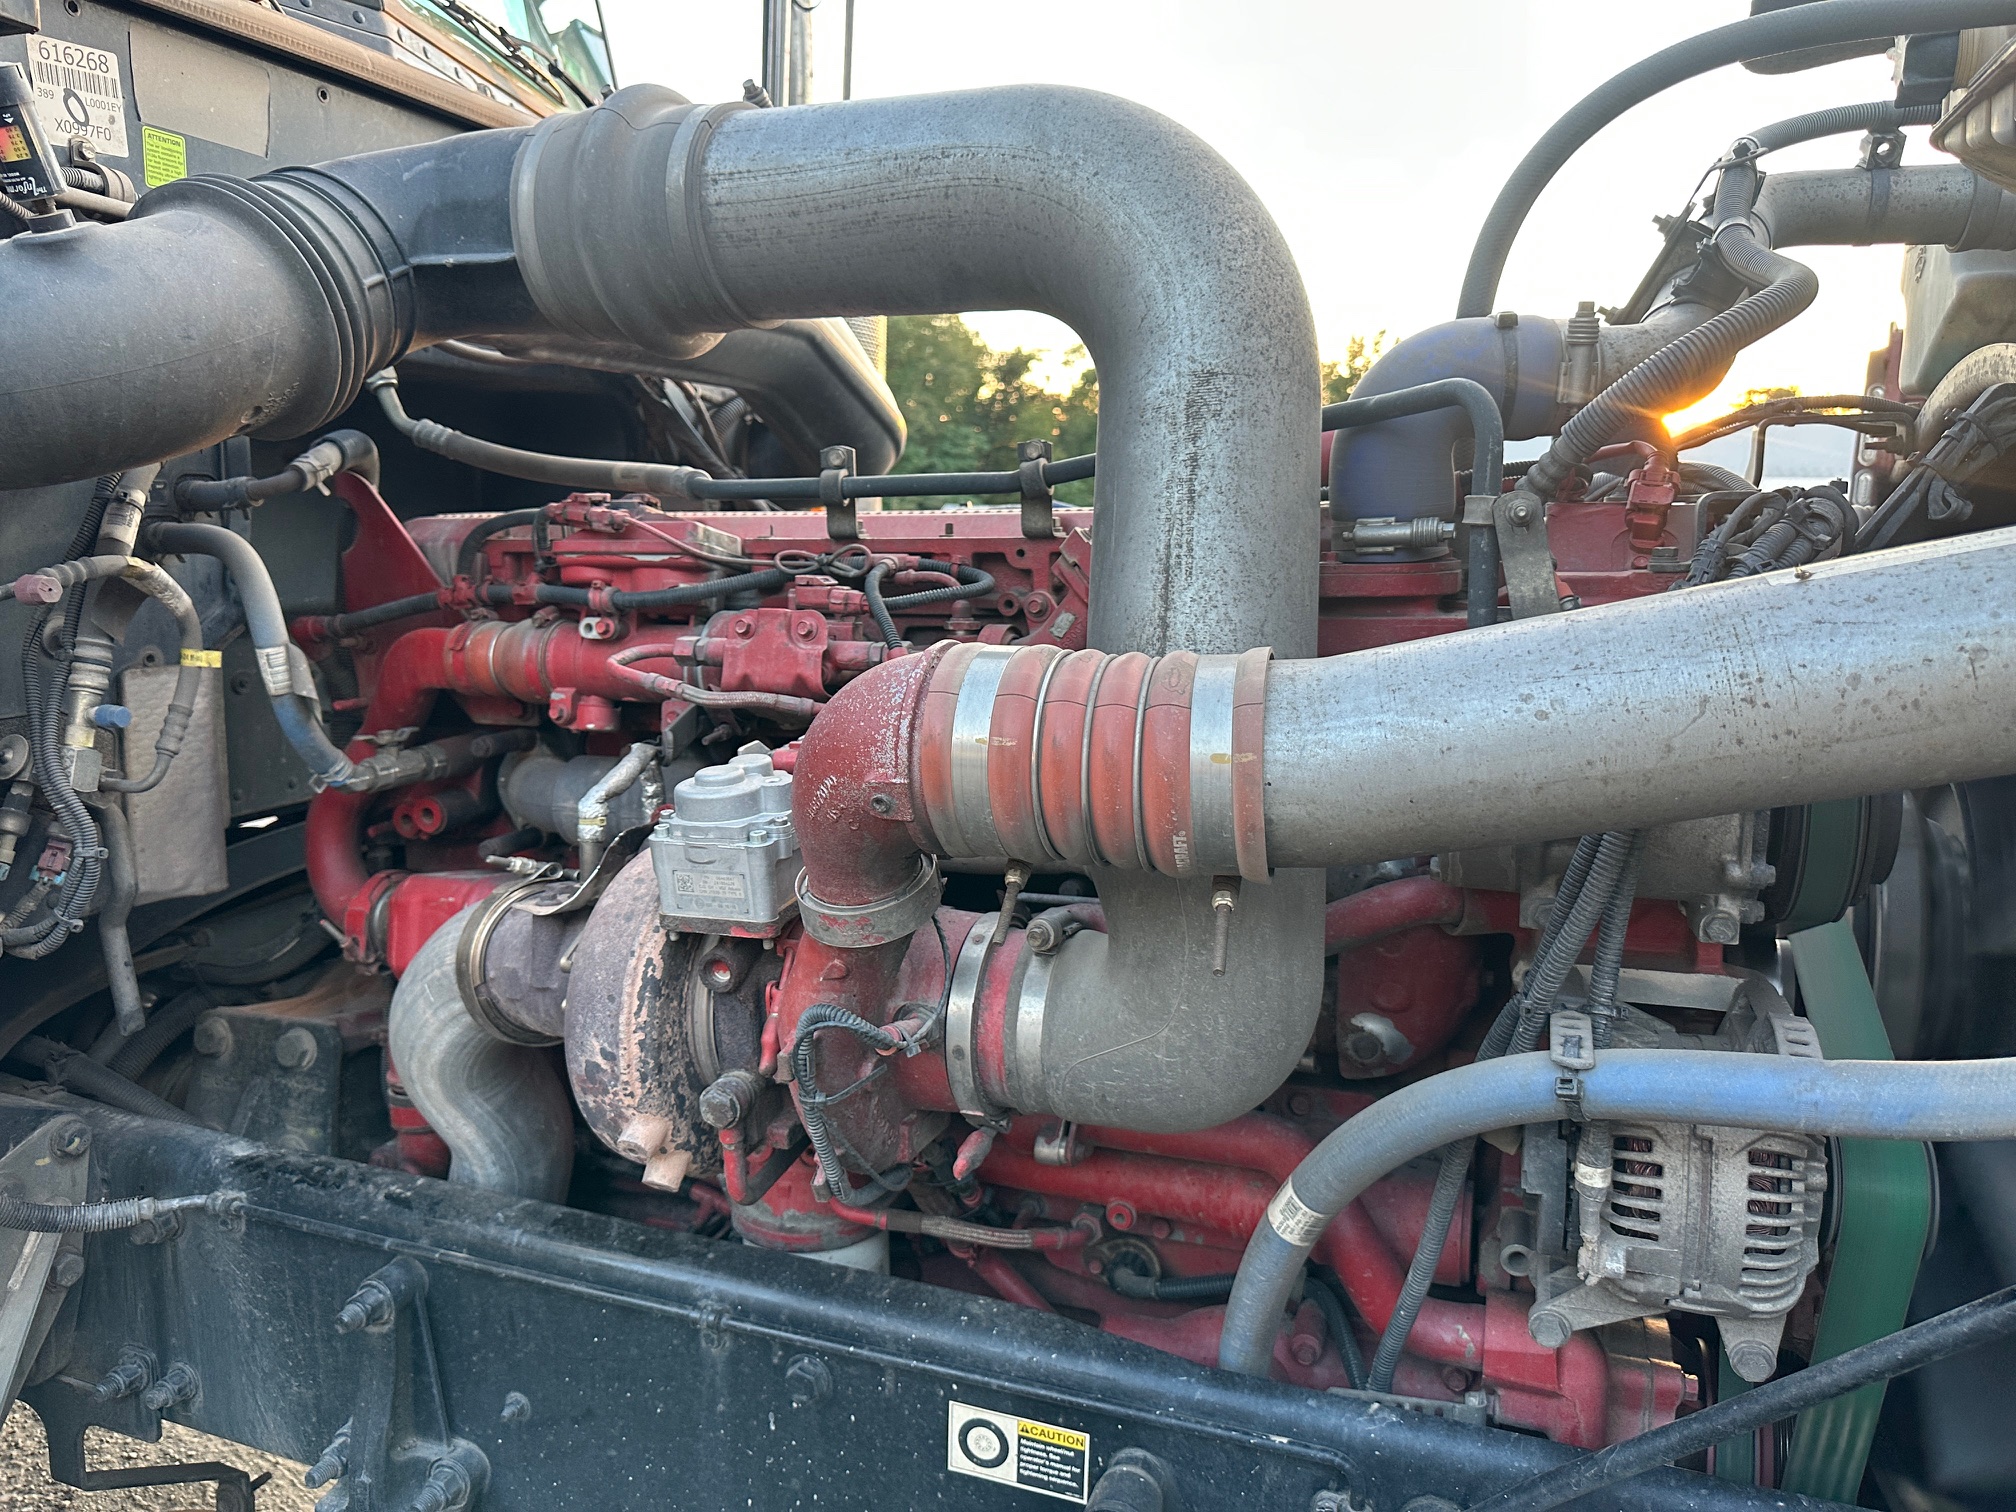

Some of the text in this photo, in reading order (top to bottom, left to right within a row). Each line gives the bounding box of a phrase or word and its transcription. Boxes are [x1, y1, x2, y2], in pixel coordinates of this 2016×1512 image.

[39, 40, 109, 74] 616268
[37, 87, 54, 100] 389
[148, 133, 181, 147] ATTENTION
[1030, 1426, 1084, 1447] CAUTION
